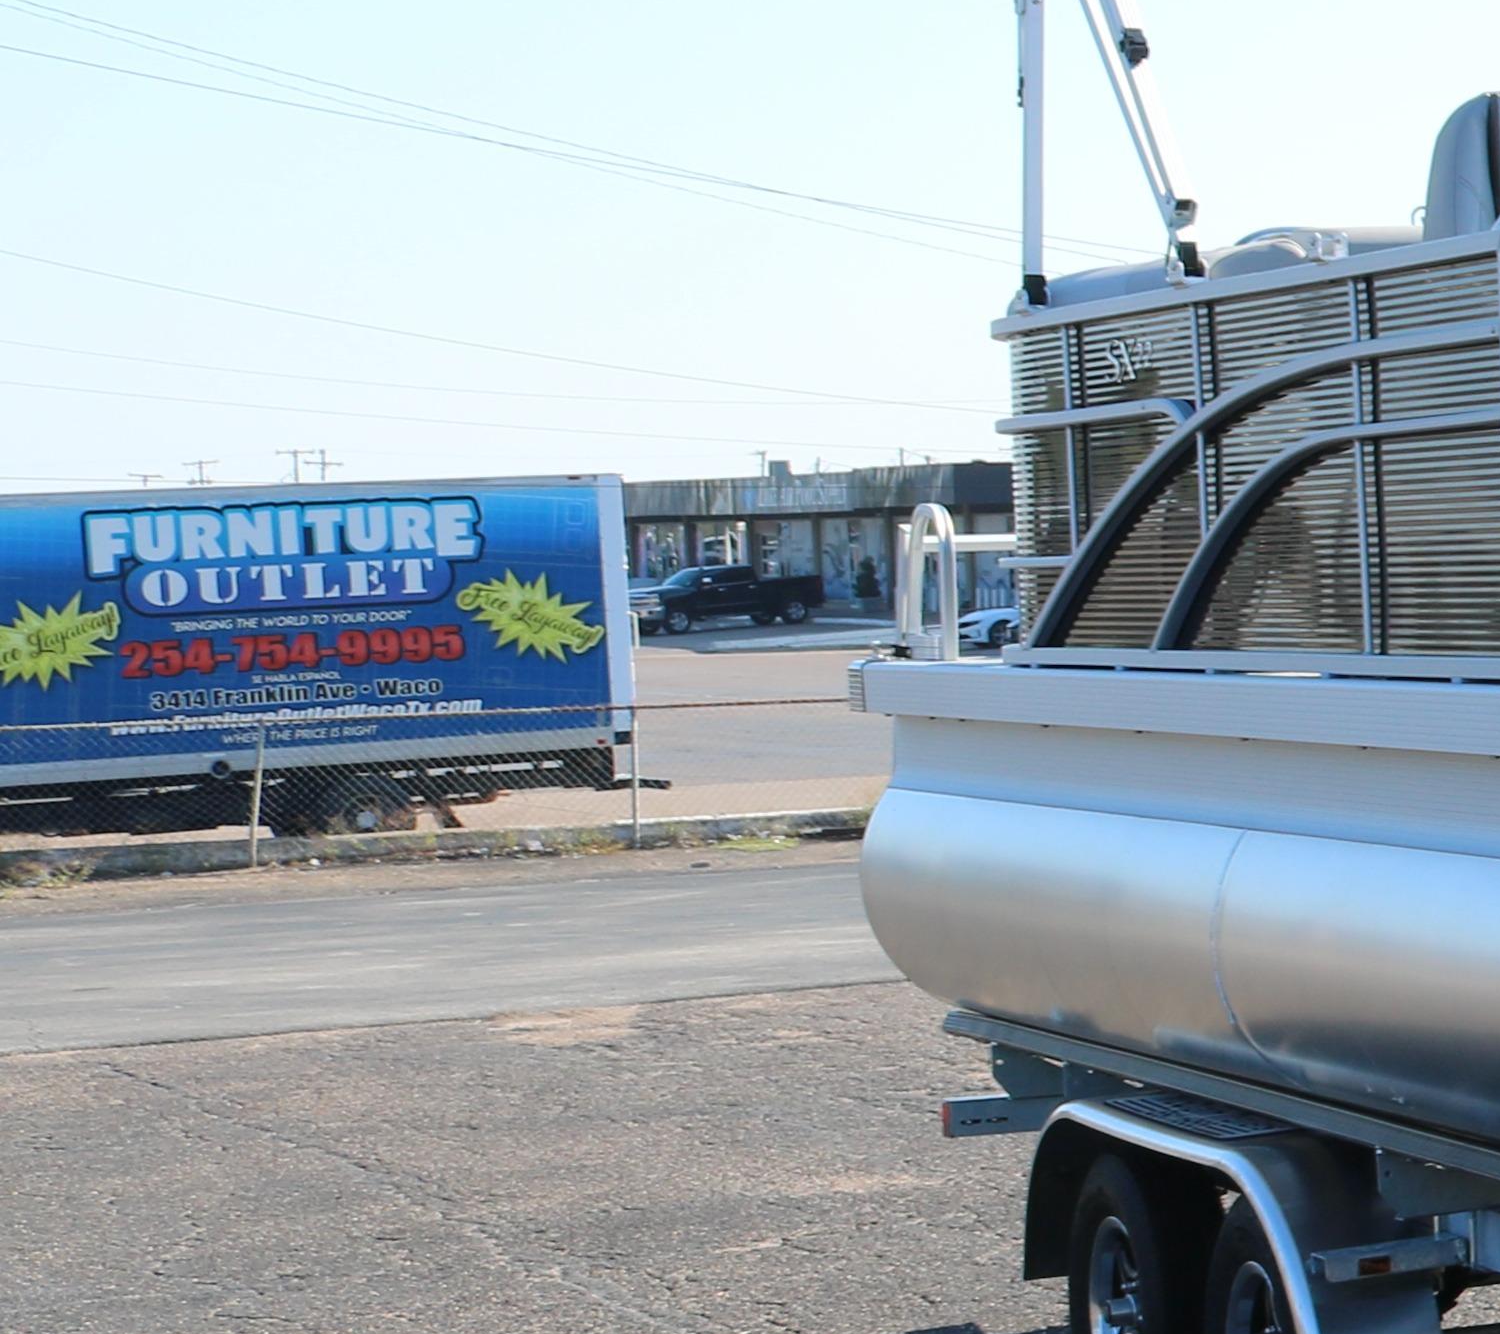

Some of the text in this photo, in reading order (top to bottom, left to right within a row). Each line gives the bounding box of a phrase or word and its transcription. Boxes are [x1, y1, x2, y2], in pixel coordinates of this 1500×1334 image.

[86, 503, 480, 575] FURNITURE
[141, 558, 435, 607] OUTLET
[237, 618, 259, 629] THE
[262, 616, 308, 628] WORLD
[312, 613, 329, 625] TO
[331, 612, 367, 624] YOUR
[119, 625, 465, 678] 254-754-9995
[151, 678, 442, 712] 3414 Franklin Ave Waco
[222, 725, 379, 744] WHER THE PRICE IS RIGHT
